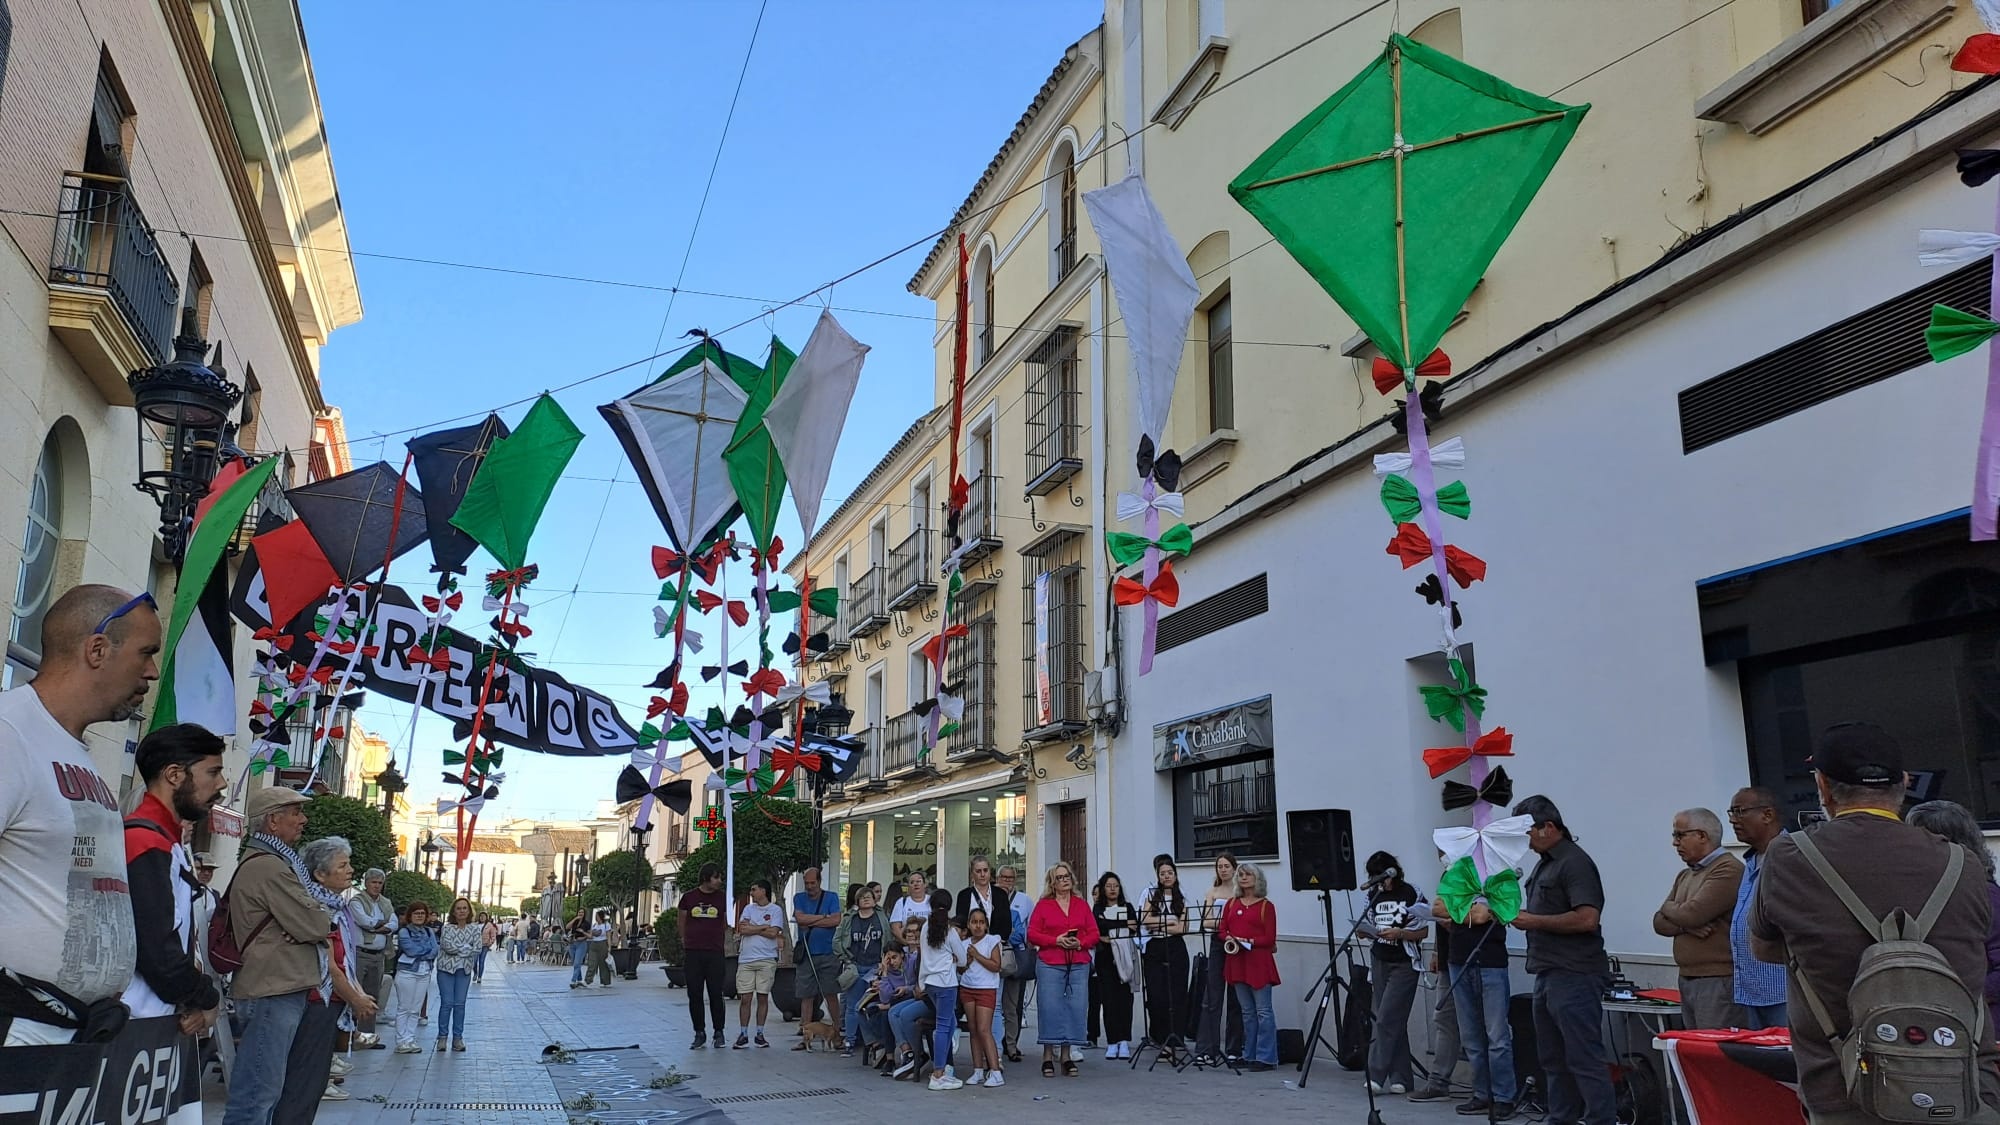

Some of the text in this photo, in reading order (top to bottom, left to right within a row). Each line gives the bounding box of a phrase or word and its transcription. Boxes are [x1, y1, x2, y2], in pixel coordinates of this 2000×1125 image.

[1192, 716, 1248, 749] CaixaBank
[70, 847, 97, 857] ALL WE
[73, 858, 93, 867] NEED
